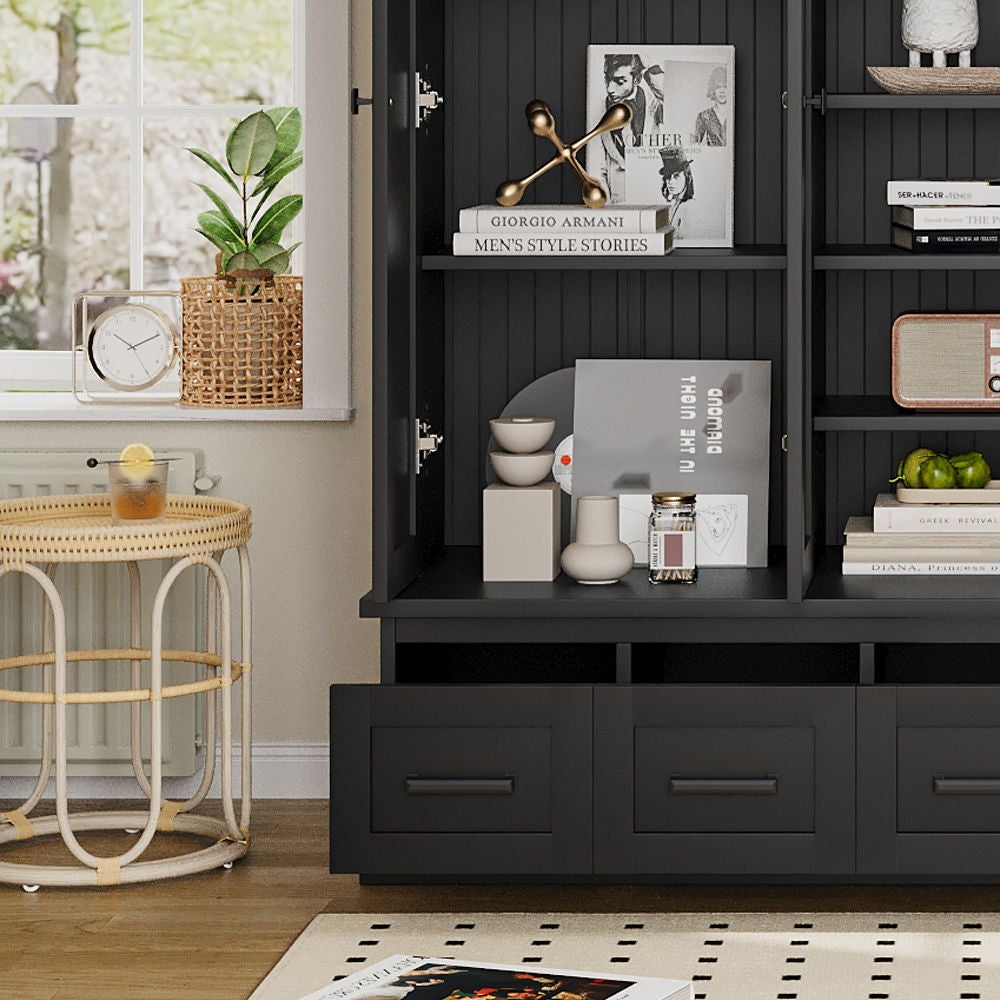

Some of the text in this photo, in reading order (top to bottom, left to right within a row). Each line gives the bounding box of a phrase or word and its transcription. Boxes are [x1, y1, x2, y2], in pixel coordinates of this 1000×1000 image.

[491, 216, 624, 228] GIORGIO ARMANI
[966, 216, 990, 225] THE
[475, 238, 648, 252] MEN'S STYLE STORIES
[871, 564, 921, 572] DIANA,
[928, 564, 986, 572] Princess
